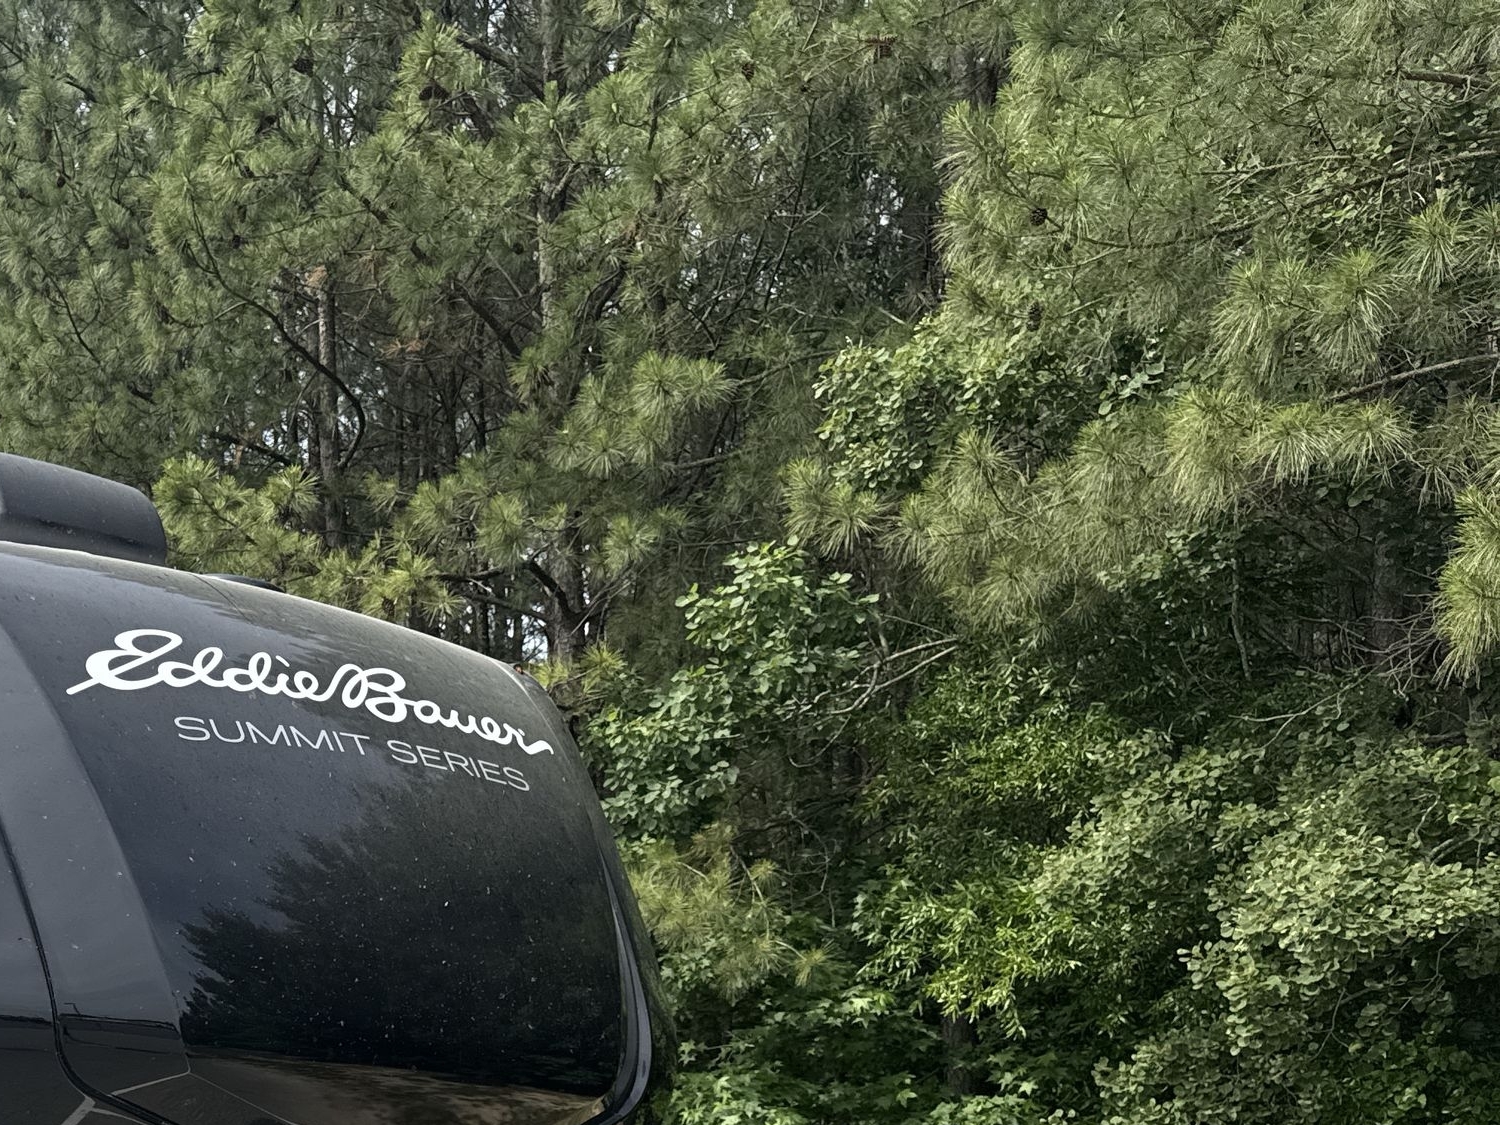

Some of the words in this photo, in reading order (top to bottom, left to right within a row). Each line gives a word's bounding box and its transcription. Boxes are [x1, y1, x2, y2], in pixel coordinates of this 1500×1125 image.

[66, 629, 330, 702] Eddie
[328, 663, 555, 755] Bauer
[173, 716, 371, 756] SUMMIT
[387, 739, 531, 792] SERIES
